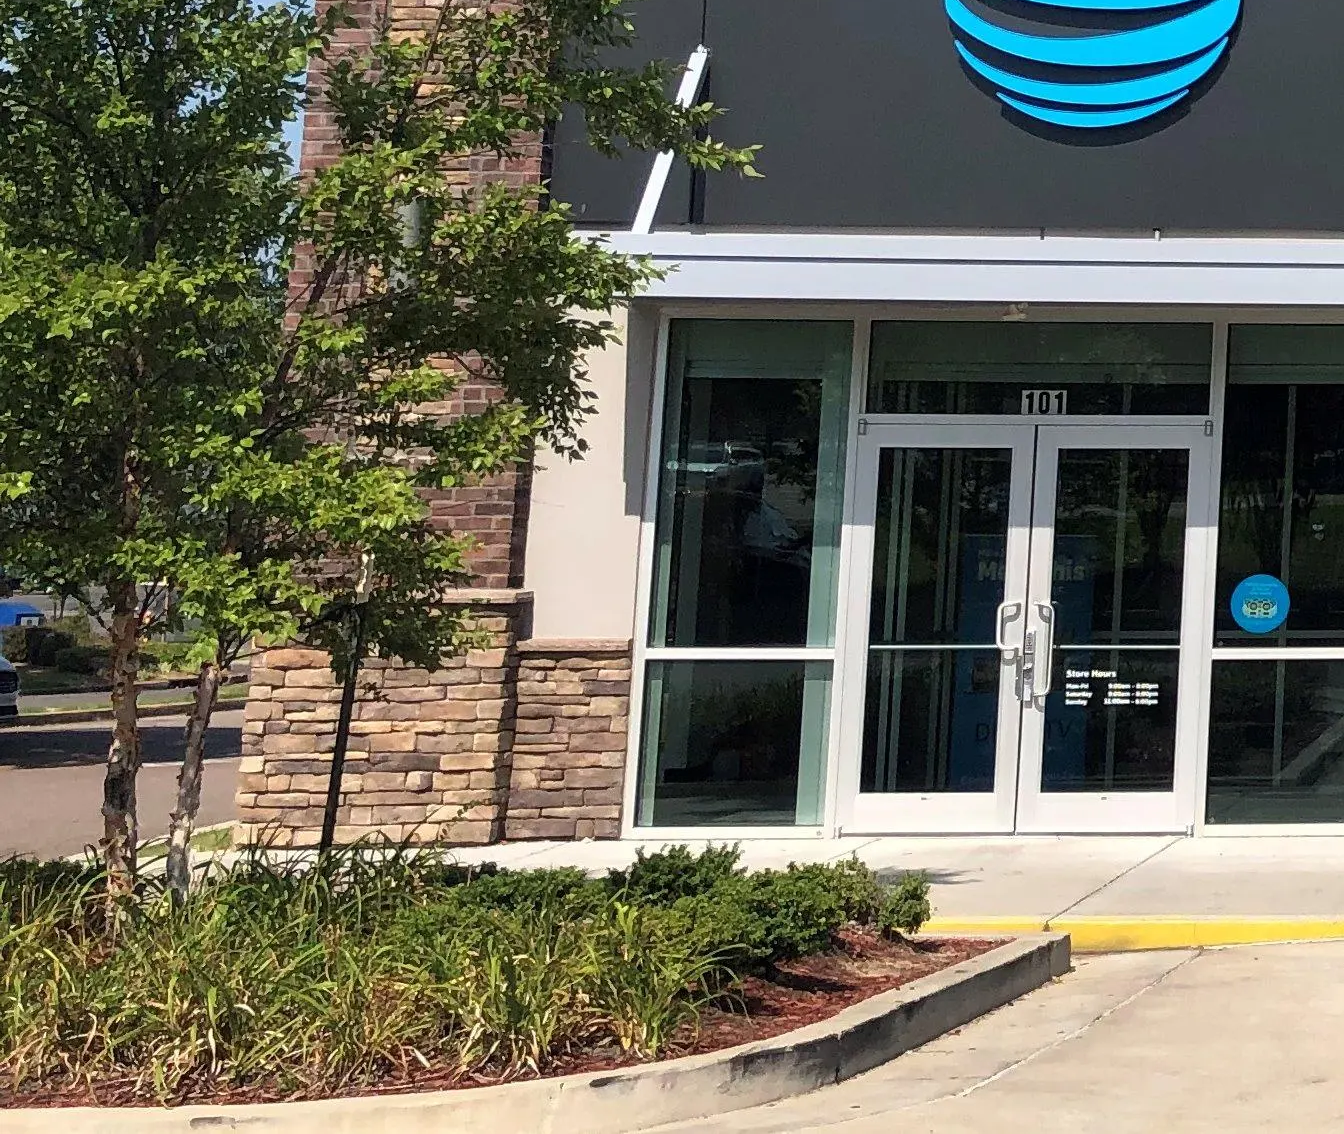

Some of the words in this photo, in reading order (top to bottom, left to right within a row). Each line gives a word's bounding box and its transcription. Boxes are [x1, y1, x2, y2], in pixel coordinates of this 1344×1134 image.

[1025, 391, 1064, 414] 101
[1065, 669, 1090, 679] Store
[1091, 669, 1117, 678] Hours
